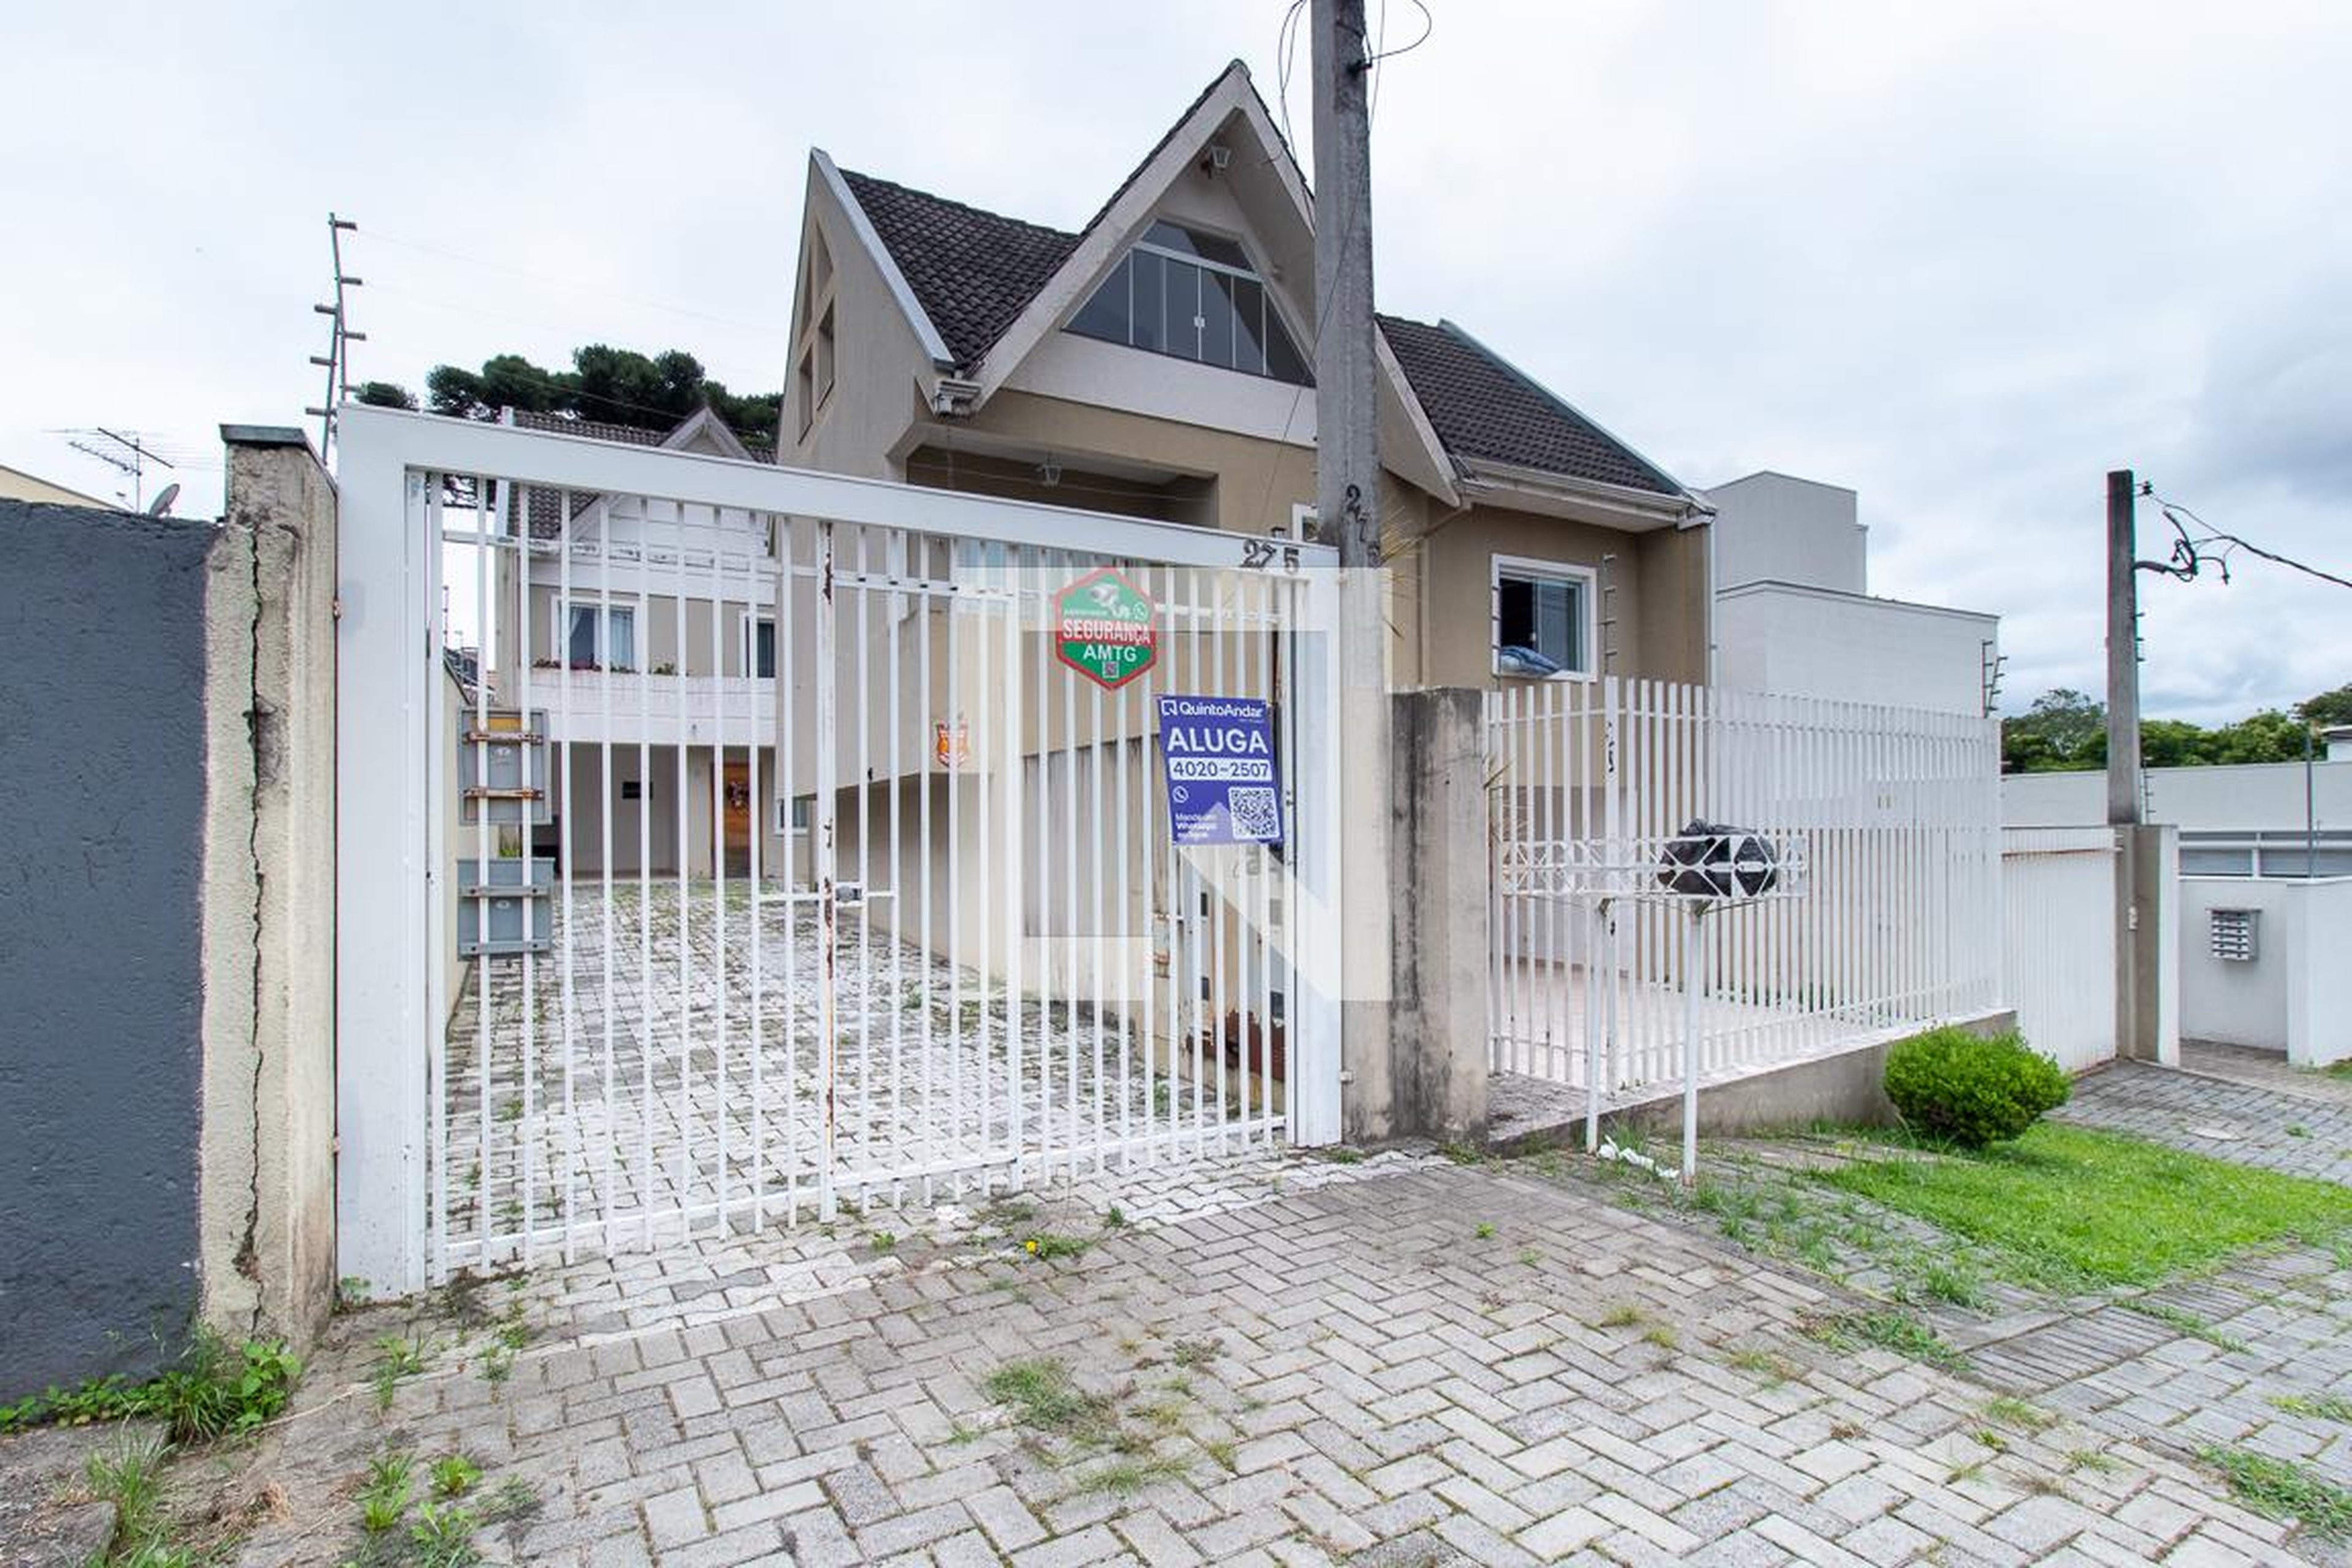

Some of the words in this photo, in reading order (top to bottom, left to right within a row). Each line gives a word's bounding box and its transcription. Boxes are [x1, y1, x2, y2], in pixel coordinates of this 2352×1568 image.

[1063, 619, 1150, 645] SEGURANÇA
[1083, 644, 1137, 662] AMTG
[1179, 701, 1264, 717] QuintoAndar
[1167, 727, 1268, 754] ALUGA
[1173, 761, 1268, 777] 4020-2507
